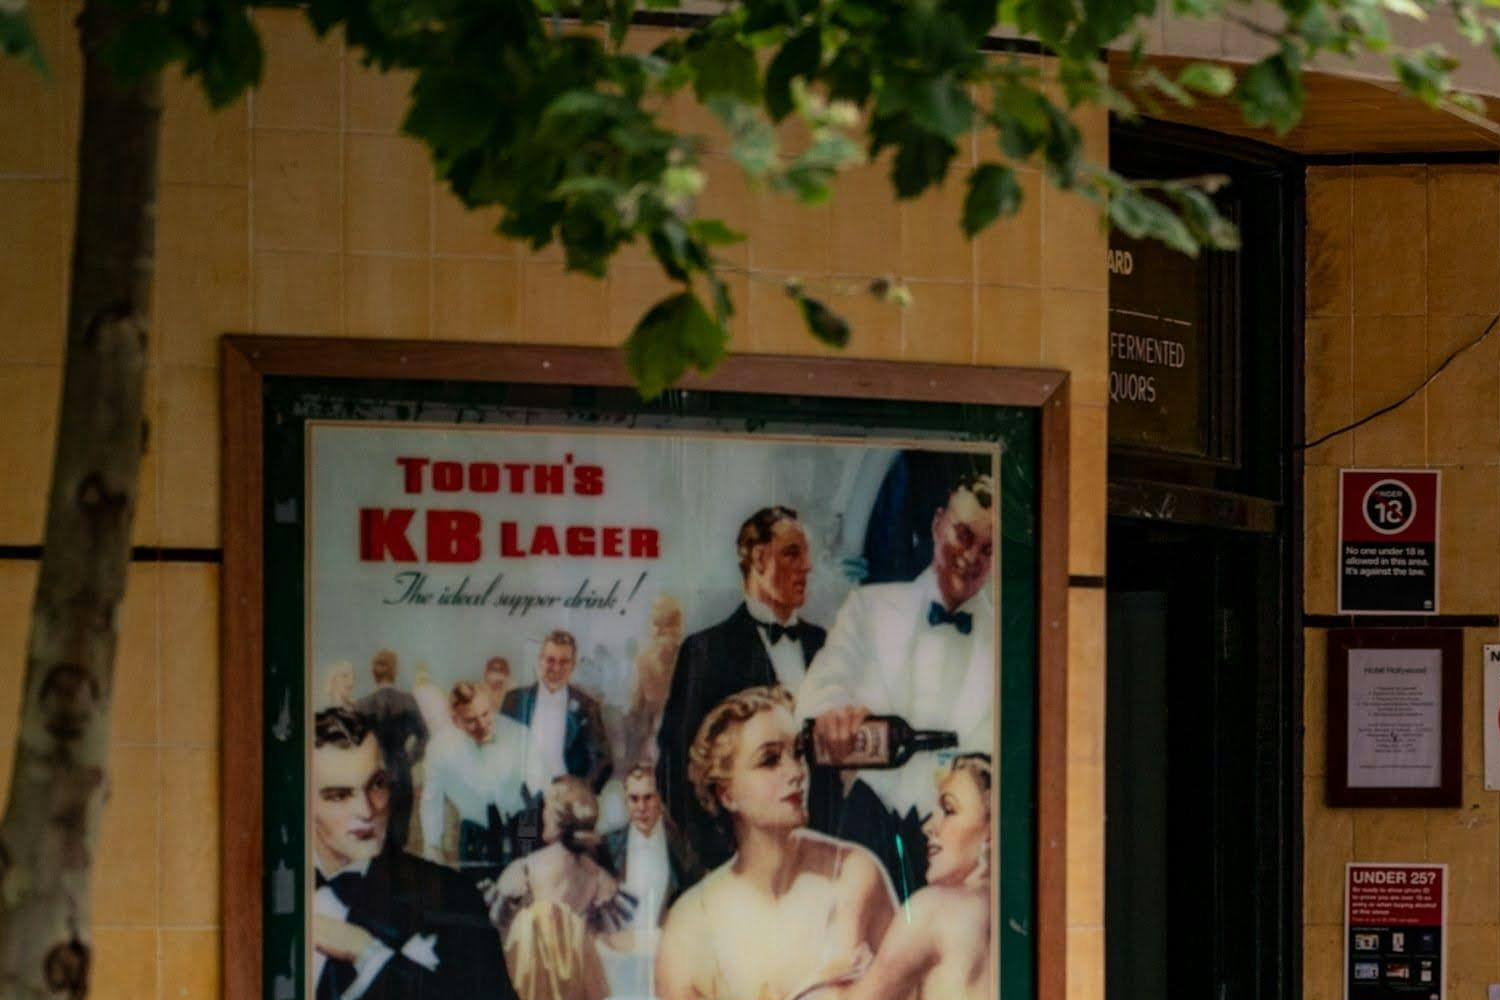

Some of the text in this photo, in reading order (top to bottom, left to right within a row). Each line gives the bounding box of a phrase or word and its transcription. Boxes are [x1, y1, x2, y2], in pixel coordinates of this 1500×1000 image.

[1110, 332, 1186, 369] FERMENTED
[396, 453, 605, 497] TOOTH'S
[359, 507, 661, 564] KB LAGER
[1345, 557, 1379, 565] allowed
[1380, 557, 1389, 565] in
[1390, 557, 1407, 565] this
[1346, 546, 1359, 555] No
[1378, 547, 1403, 555] under
[1406, 547, 1416, 555] 18
[1417, 547, 1425, 555] is
[1360, 568, 1391, 577] against
[1393, 567, 1407, 575] the
[383, 571, 434, 607] The
[437, 573, 503, 608] ideal
[494, 594, 564, 617] supper
[1352, 871, 1436, 885] UNDER 25?
